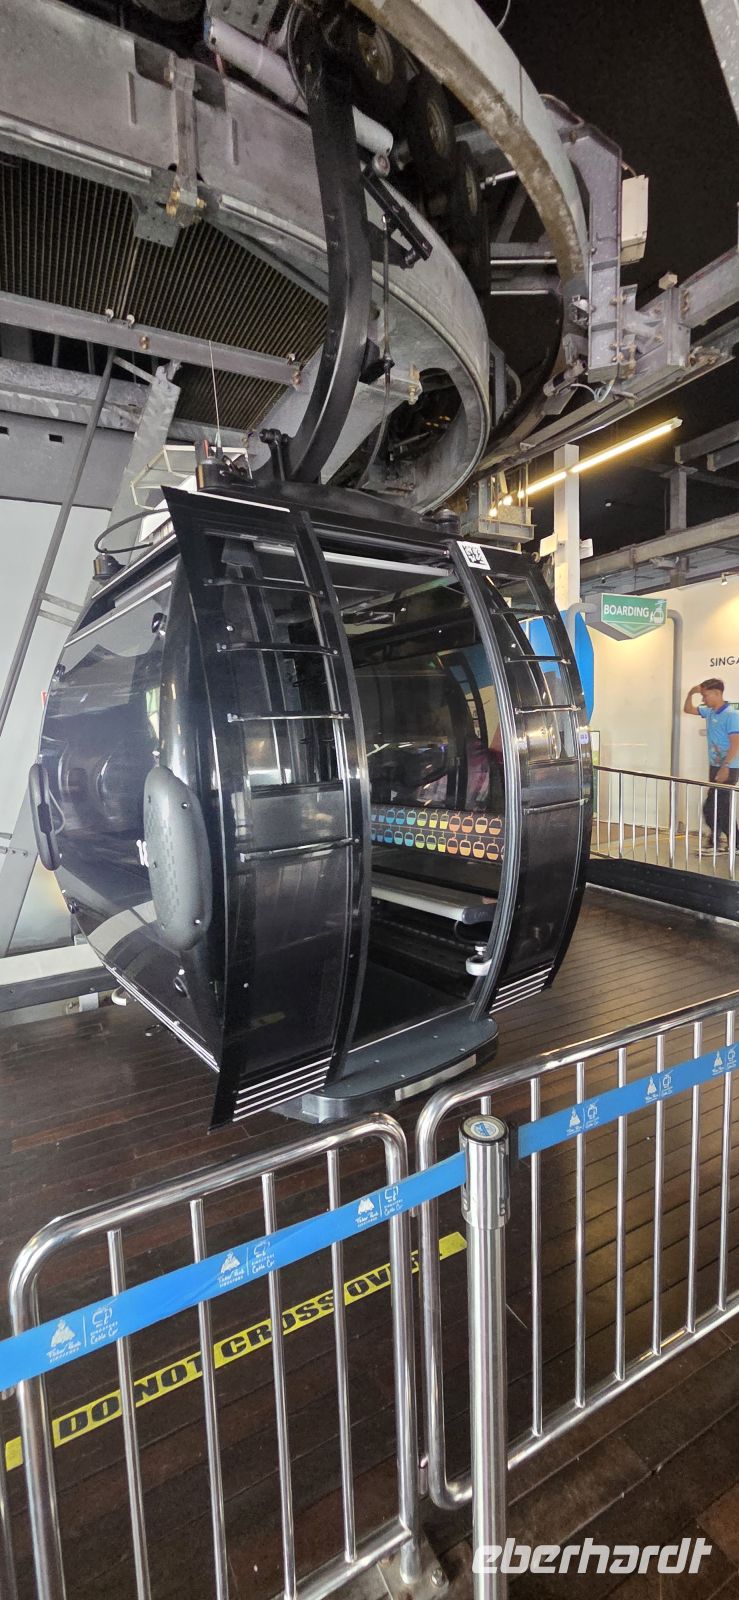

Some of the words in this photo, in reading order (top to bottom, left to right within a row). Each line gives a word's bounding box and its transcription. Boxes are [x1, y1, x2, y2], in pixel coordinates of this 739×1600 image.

[603, 603, 650, 618] BOARDING
[58, 1396, 120, 1440] DO
[132, 1354, 203, 1402] NOT
